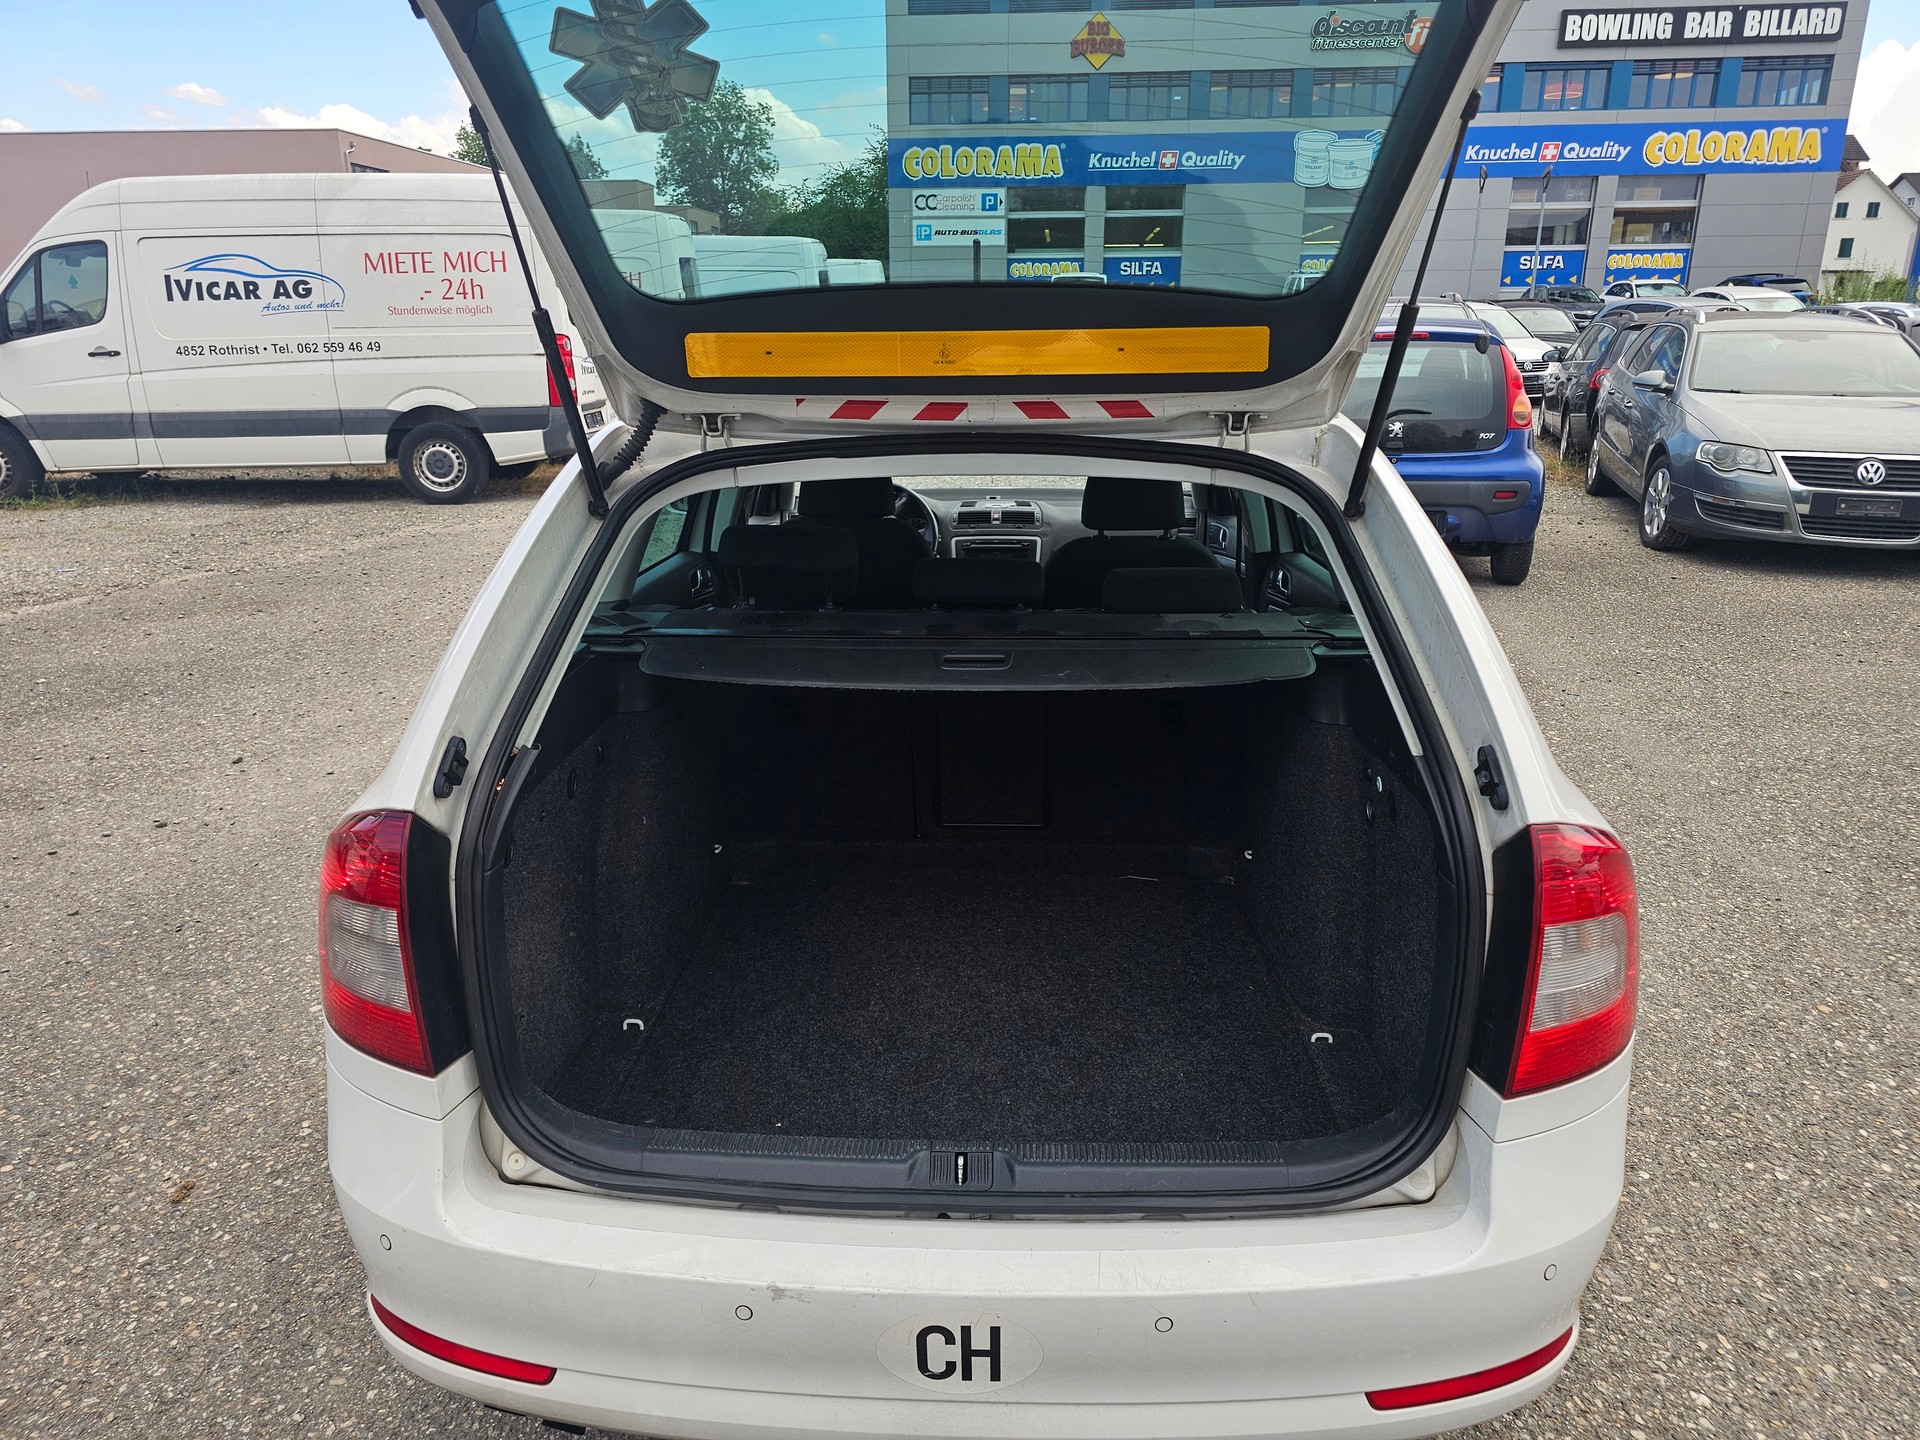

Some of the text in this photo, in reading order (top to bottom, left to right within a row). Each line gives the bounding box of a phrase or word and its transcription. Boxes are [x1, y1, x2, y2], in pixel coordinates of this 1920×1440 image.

[1087, 21, 1110, 35] BIG
[1564, 7, 1843, 41] BOWLING BAR BILLARD
[1071, 37, 1125, 58] BURGER
[1311, 37, 1404, 50] fitnesscenter
[1465, 141, 1631, 162] Knuchel Quality
[1643, 127, 1822, 167] COLORAMA
[903, 143, 1066, 180] COLORAMA
[1088, 150, 1246, 170] Knuchel Quality
[936, 194, 976, 204] Carpolish
[936, 203, 975, 212] Cleaning
[364, 251, 507, 274] MIETE MICH
[1010, 261, 1080, 277] COLORAMA
[1120, 261, 1163, 276] SILFA
[1519, 255, 1565, 270] SILFA
[1607, 252, 1684, 270] COLORAMA
[164, 274, 312, 302] IVICAR AG
[441, 278, 484, 300] 24h
[261, 302, 290, 312] Autos
[295, 301, 313, 310] und
[387, 304, 493, 316] Stundenweise möglich
[175, 341, 381, 356] 4852 Rothrist Tel. 062 559 46 49
[1479, 432, 1495, 440] 107
[915, 1324, 1001, 1382] CH
